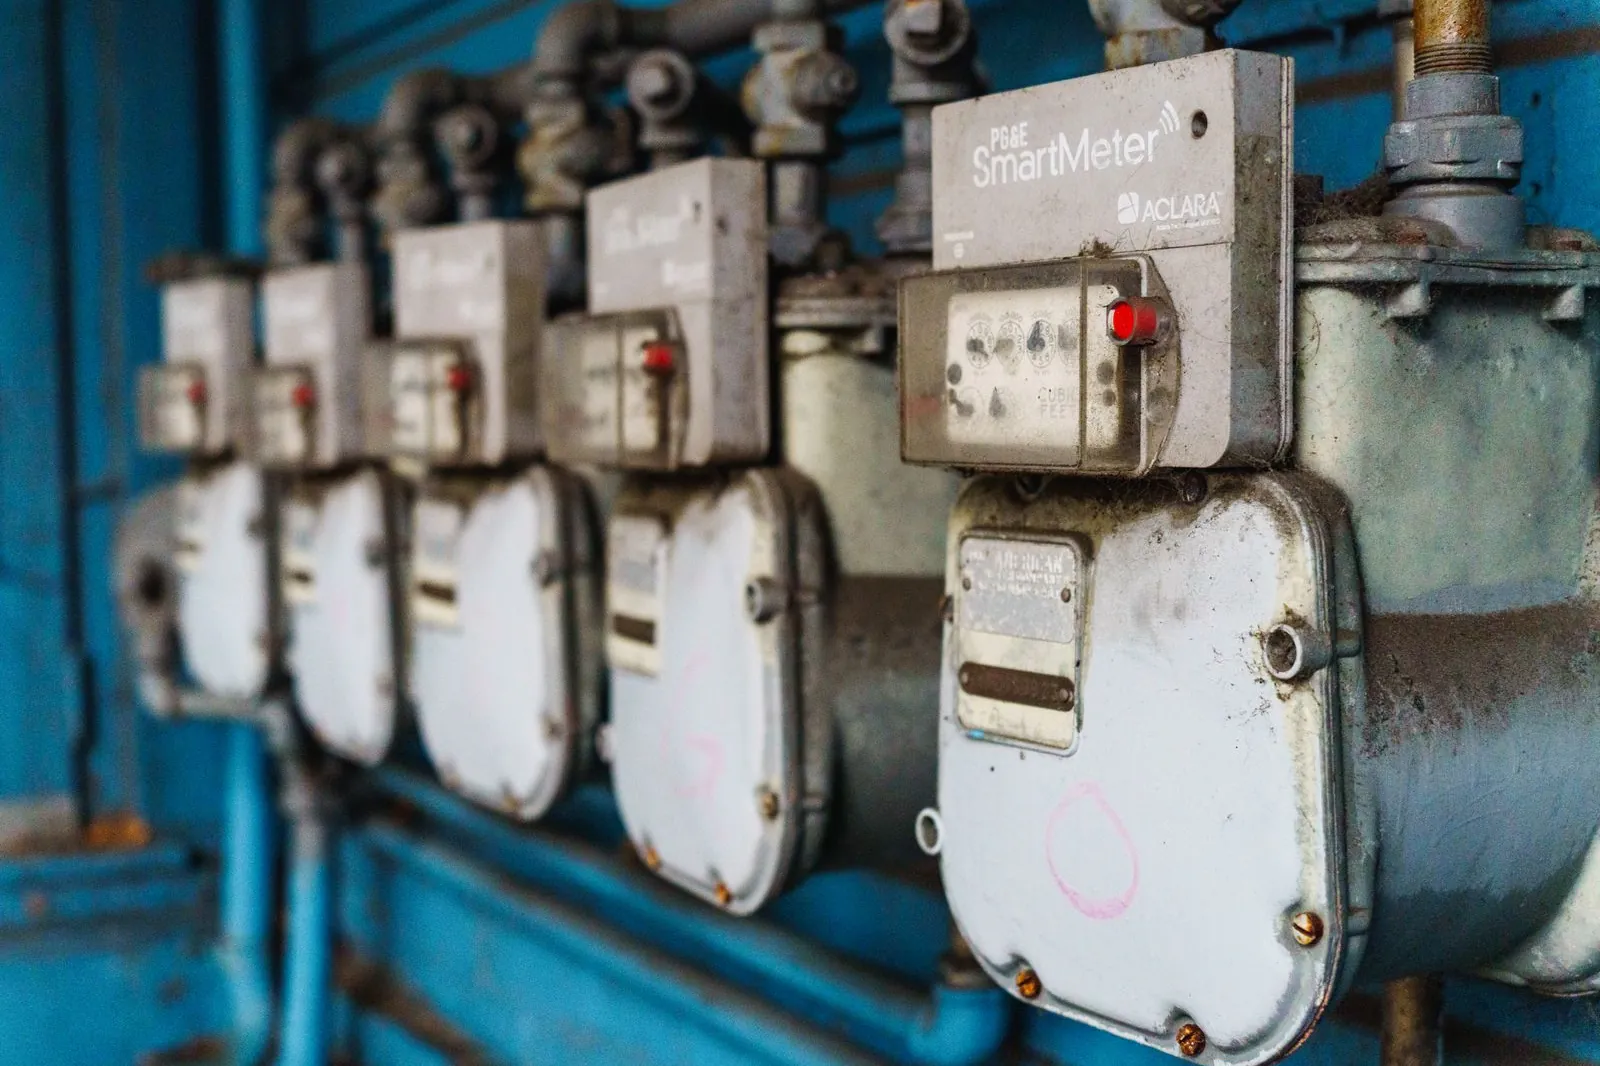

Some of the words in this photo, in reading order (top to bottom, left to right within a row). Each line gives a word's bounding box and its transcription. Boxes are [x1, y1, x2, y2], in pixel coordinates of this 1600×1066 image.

[990, 121, 1028, 151] PG&E
[973, 128, 1160, 188] SmartMeter
[1141, 191, 1221, 223] ACLARA
